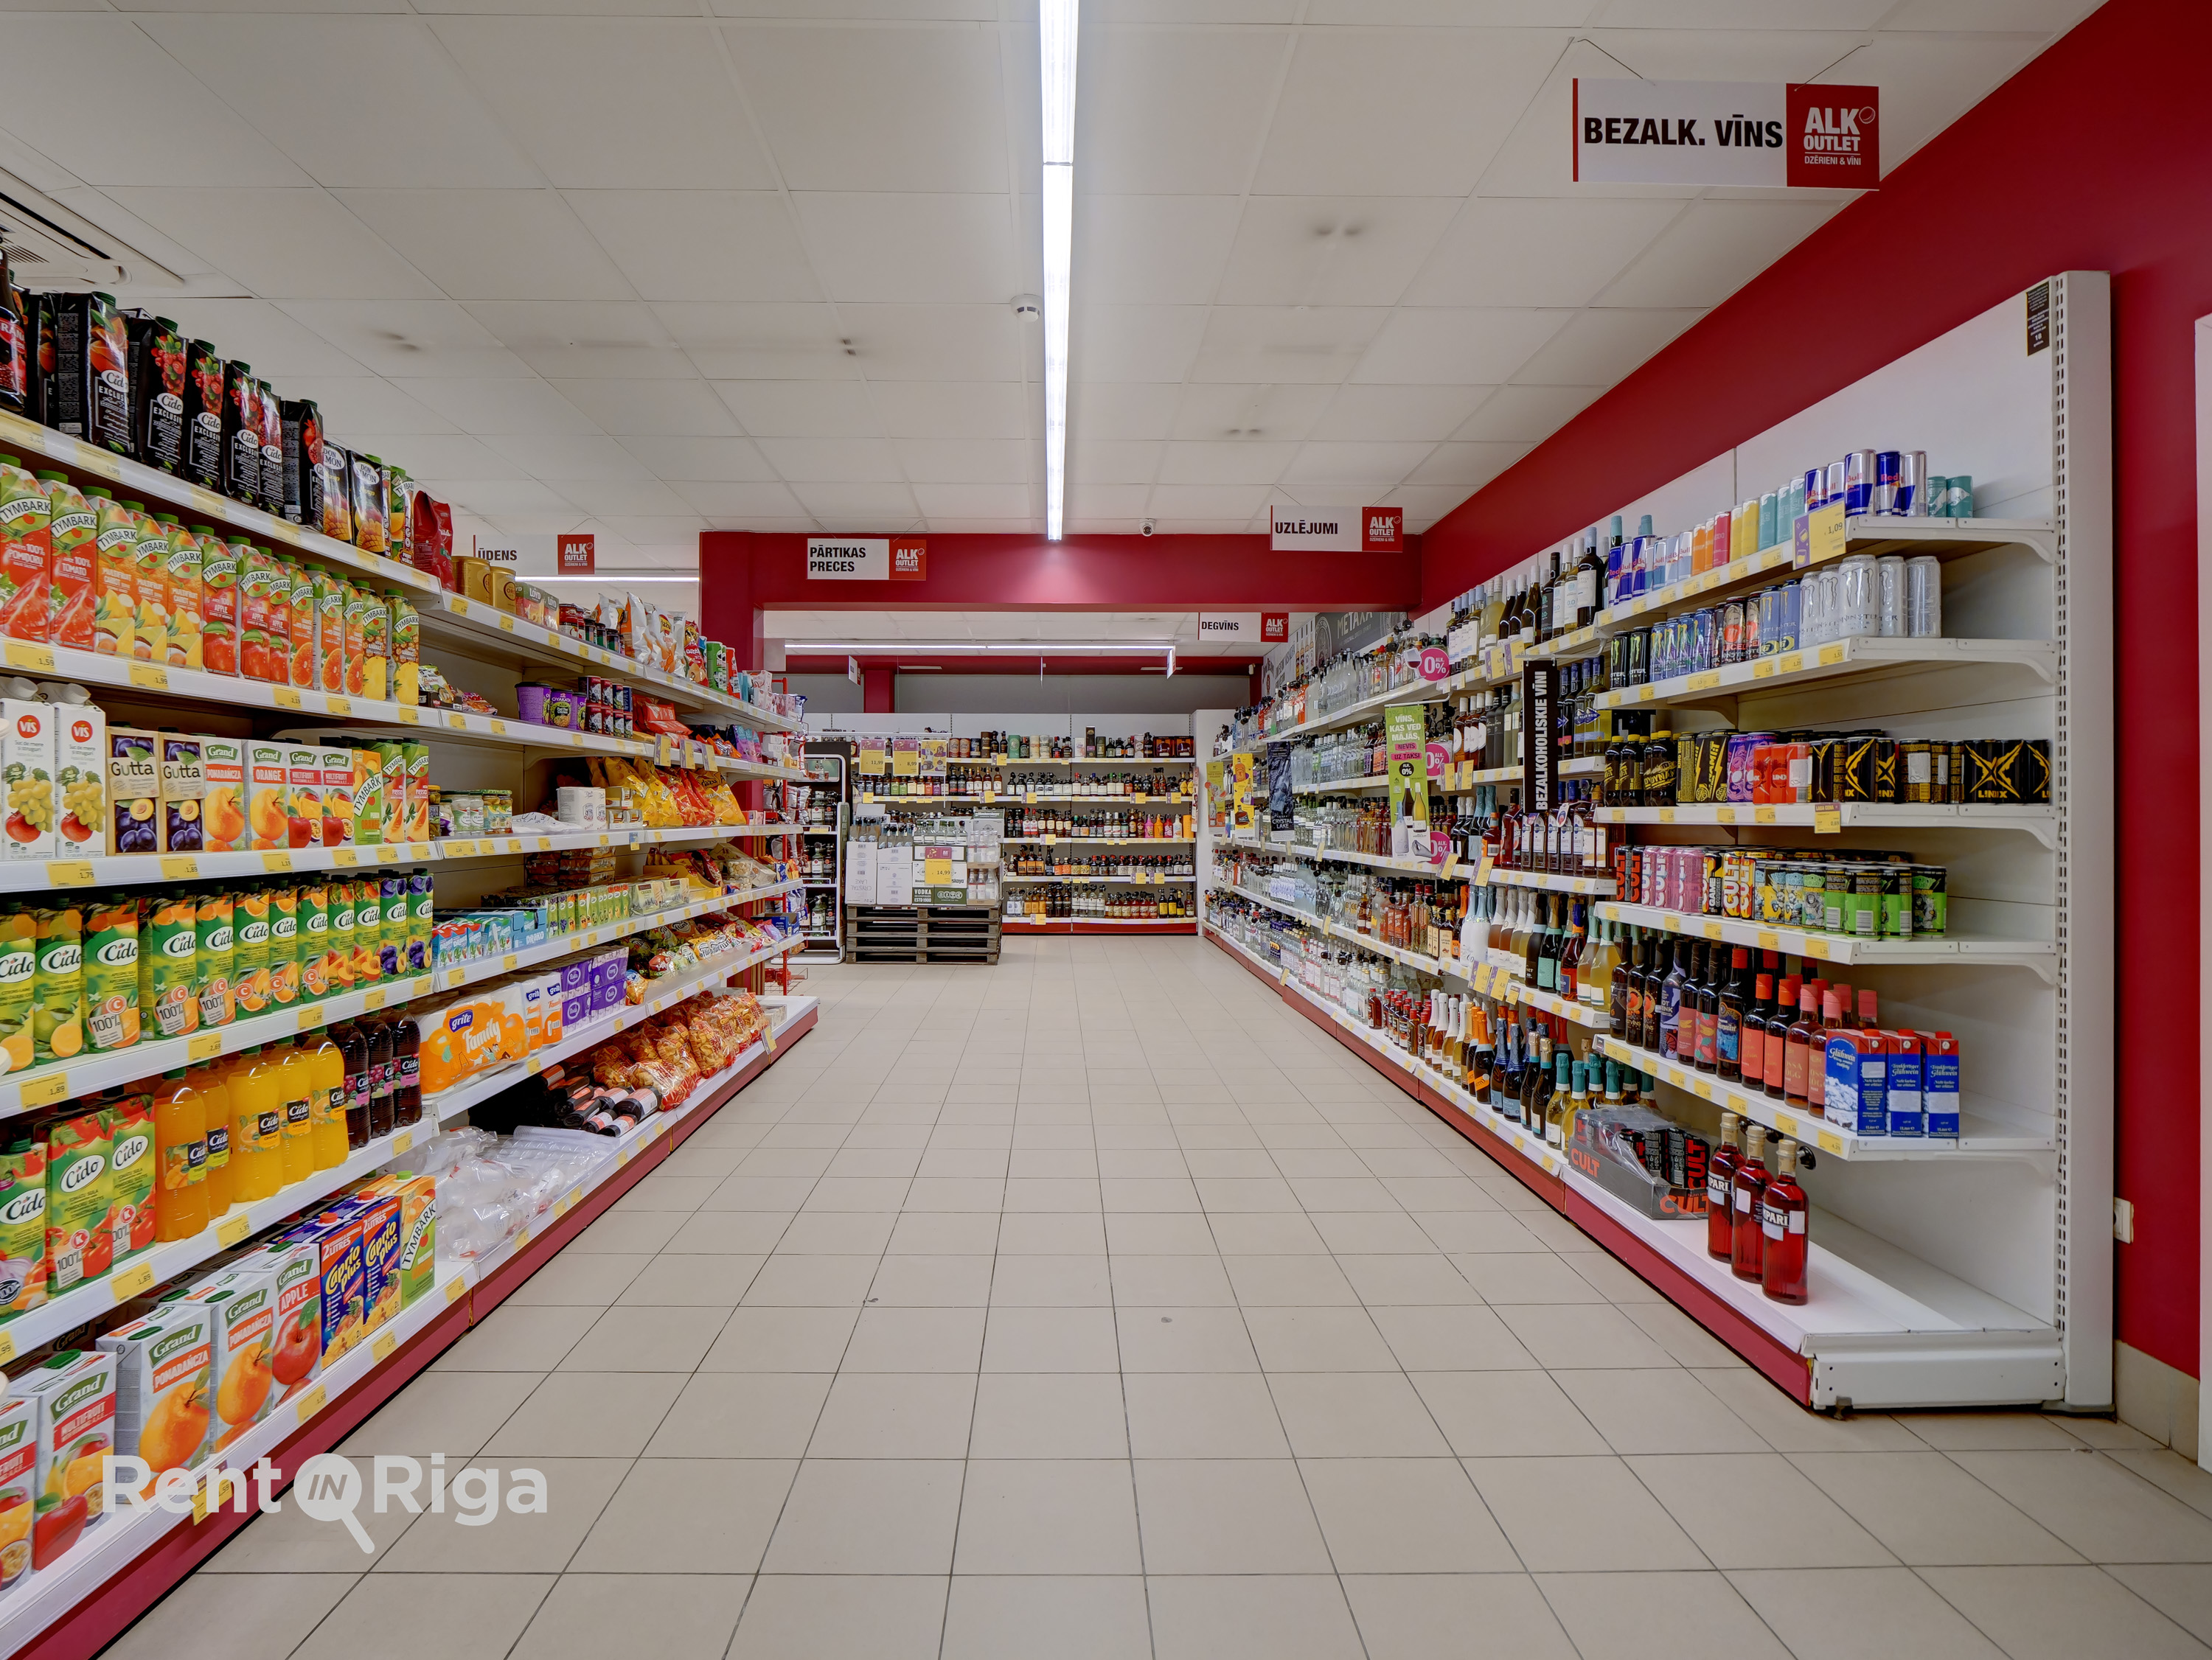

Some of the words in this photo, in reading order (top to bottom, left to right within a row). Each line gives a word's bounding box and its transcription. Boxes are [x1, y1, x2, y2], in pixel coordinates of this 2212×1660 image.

[1804, 107, 1860, 135] ALK
[1584, 117, 1705, 146] BEZALK.
[1714, 114, 1783, 147] VĪNS
[1804, 135, 1860, 151] OUTLET
[1804, 155, 1837, 165] DZĒRIENI
[1839, 157, 1845, 165] &
[1846, 156, 1861, 165] VĪNI
[161, 397, 182, 411] Cido
[201, 414, 220, 429] Cido
[240, 431, 258, 445] Cido
[265, 447, 282, 460] Cido
[323, 448, 336, 458] DON
[361, 464, 372, 473] DON
[1, 501, 52, 520] TYMBARK
[52, 515, 97, 533] TYMBARK
[1275, 520, 1338, 534] UZLĒJUMI
[1370, 517, 1394, 529] ALK
[1829, 523, 1843, 534] 1,09
[99, 529, 137, 548] TYMBARK
[479, 548, 517, 561] ŪDENS
[565, 544, 587, 554] ALK
[810, 545, 866, 557] PĀRTIKAS
[896, 549, 918, 559] ALK
[168, 552, 202, 569] TYMBARK
[203, 559, 237, 577] TYMBARK
[810, 562, 855, 571] PRECES
[62, 562, 87, 576] TOMATO
[291, 586, 313, 606] TYMBARK
[215, 604, 228, 613] APPLE
[363, 609, 386, 624] TYMBARK
[251, 613, 264, 621] APPLE
[394, 615, 419, 633] TYMBARK
[1201, 621, 1239, 630] DEGVĪNS
[155, 677, 168, 685] 1,99
[1533, 671, 1547, 697] VĪNI
[1395, 714, 1414, 722] VĪNS,
[20, 721, 37, 733] VIS
[74, 726, 89, 738] VIS
[1392, 732, 1419, 741] MĀJĀS,
[208, 746, 234, 758] Grand
[255, 749, 280, 759] Grand
[291, 753, 313, 764] Grand
[325, 755, 347, 765] Grand
[1535, 699, 1548, 810] BEZALKOHOLISKIE
[111, 761, 155, 776] Gutta
[163, 764, 201, 778] Gutta
[256, 768, 282, 780] ORANGE
[408, 758, 428, 774] TYMBARK
[292, 772, 314, 780] MULTIFRUIT
[355, 776, 382, 811] TYMBARK
[1631, 854, 1640, 902] CULT
[1724, 857, 1740, 910] CULT
[1740, 858, 1750, 910] CULT
[158, 1004, 184, 1021] 100%
[201, 997, 224, 1013] 100%
[92, 1014, 121, 1032] 100%
[451, 1013, 473, 1030] grite
[462, 1019, 501, 1053] Family
[1829, 1048, 1856, 1061] Glühwein
[402, 1060, 418, 1070] Cido
[49, 1086, 65, 1095] 1,89
[289, 1106, 308, 1117] Cido
[116, 1137, 144, 1167] Cido
[1571, 1148, 1600, 1178] CULT
[1688, 1140, 1705, 1190] CULT
[65, 1159, 99, 1189] Cido
[1660, 1195, 1708, 1214] CULT
[369, 1213, 387, 1230] LITRES
[402, 1204, 435, 1265] TYMBARK
[323, 1246, 330, 1262] 2
[332, 1237, 351, 1257] LITRES
[366, 1221, 397, 1266] Caprio
[380, 1233, 397, 1265] plus
[57, 1249, 83, 1272] 100%
[279, 1260, 307, 1286] Grand
[326, 1246, 361, 1294] Caprio
[341, 1259, 361, 1292] plus
[281, 1284, 309, 1311] APPLE
[227, 1297, 263, 1320] Grand
[153, 1328, 197, 1358] Grand
[55, 1374, 102, 1412] Grand
